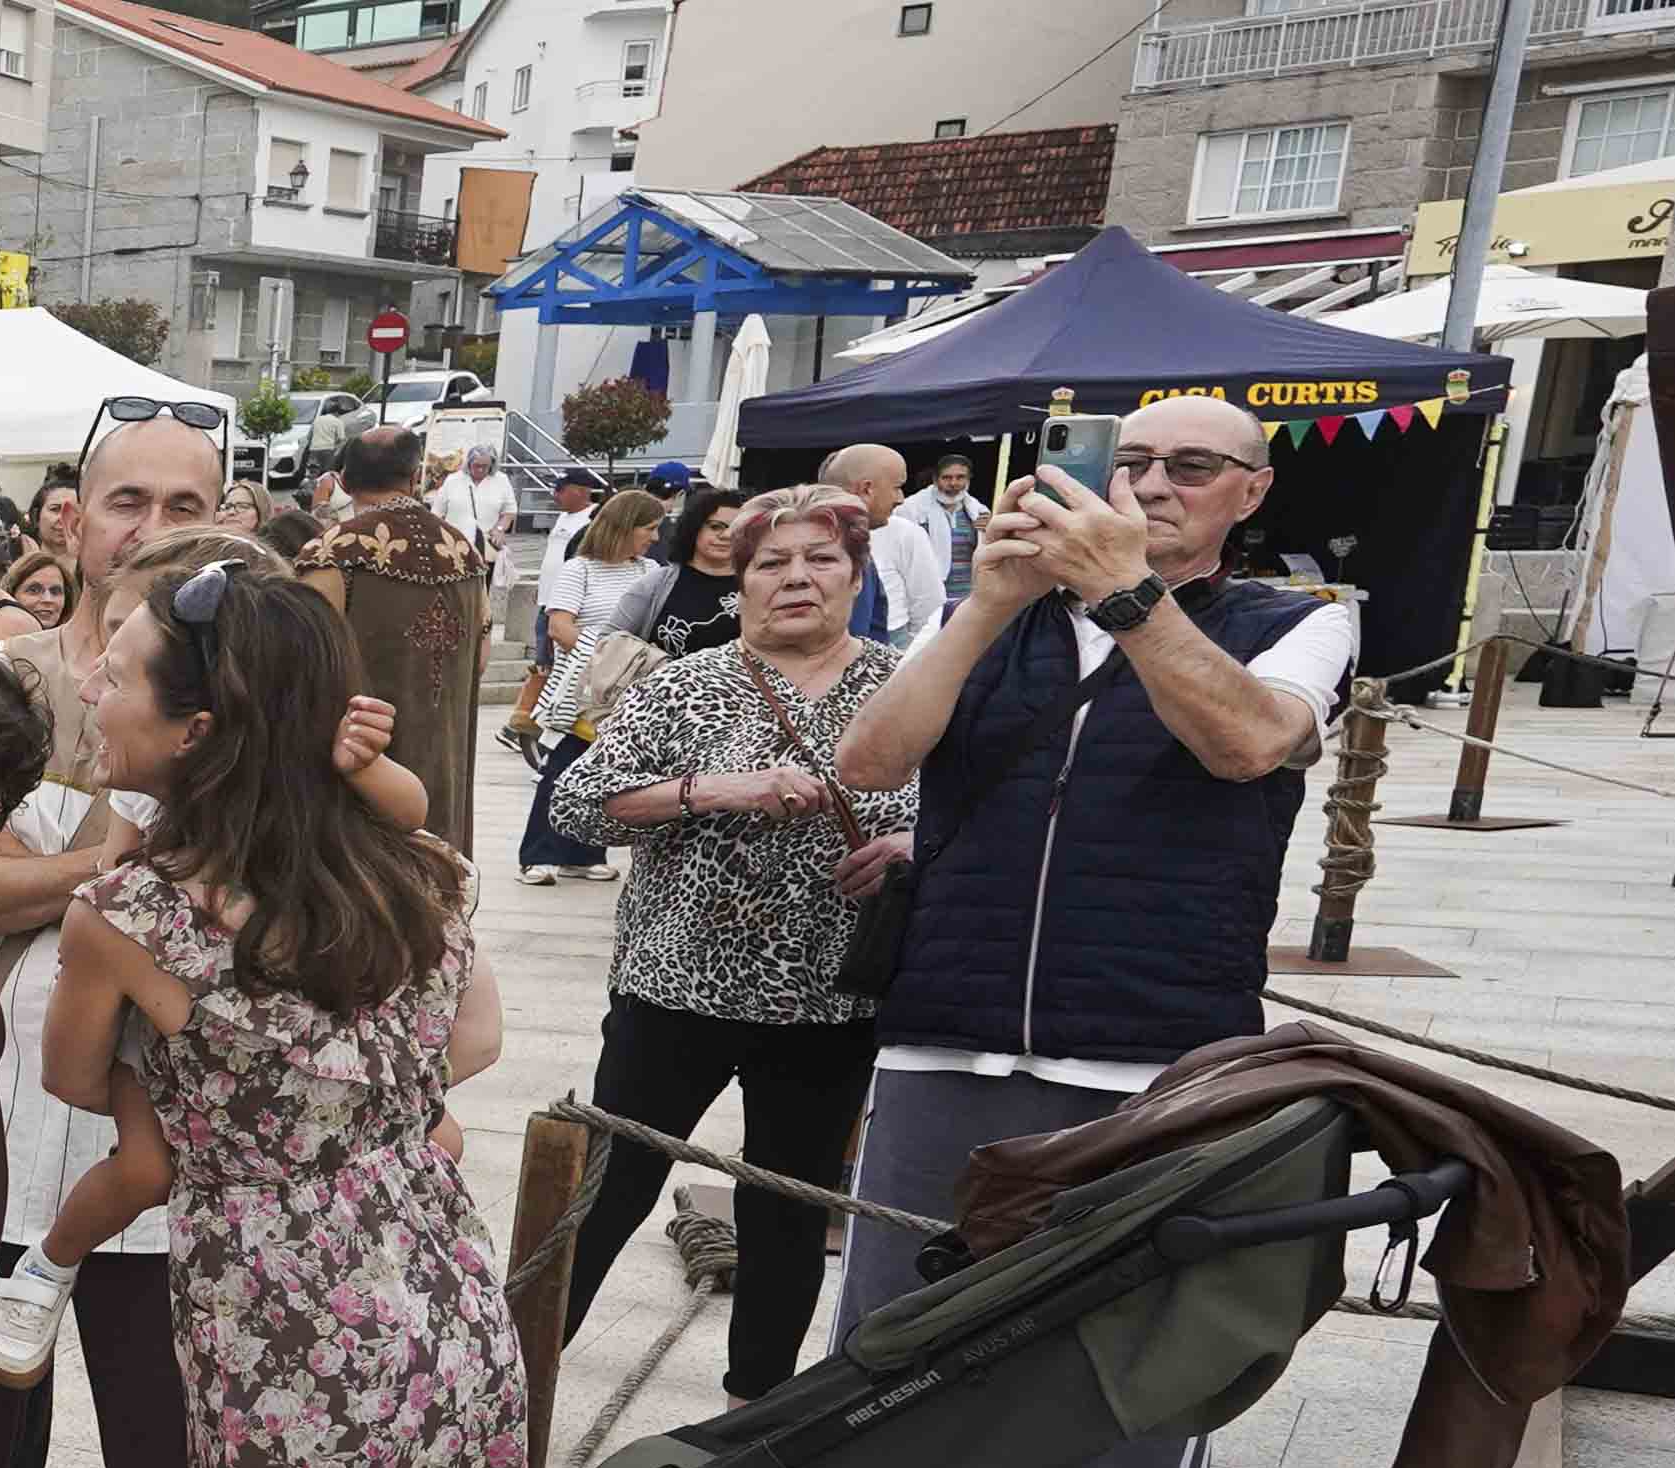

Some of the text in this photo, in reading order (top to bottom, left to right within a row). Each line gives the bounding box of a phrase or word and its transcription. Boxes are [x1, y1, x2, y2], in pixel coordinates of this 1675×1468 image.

[1246, 380, 1380, 408] CURTIS
[1010, 1316, 1036, 1341] AIR
[845, 1402, 883, 1428] ABC
[878, 1368, 943, 1409] DESIGN
